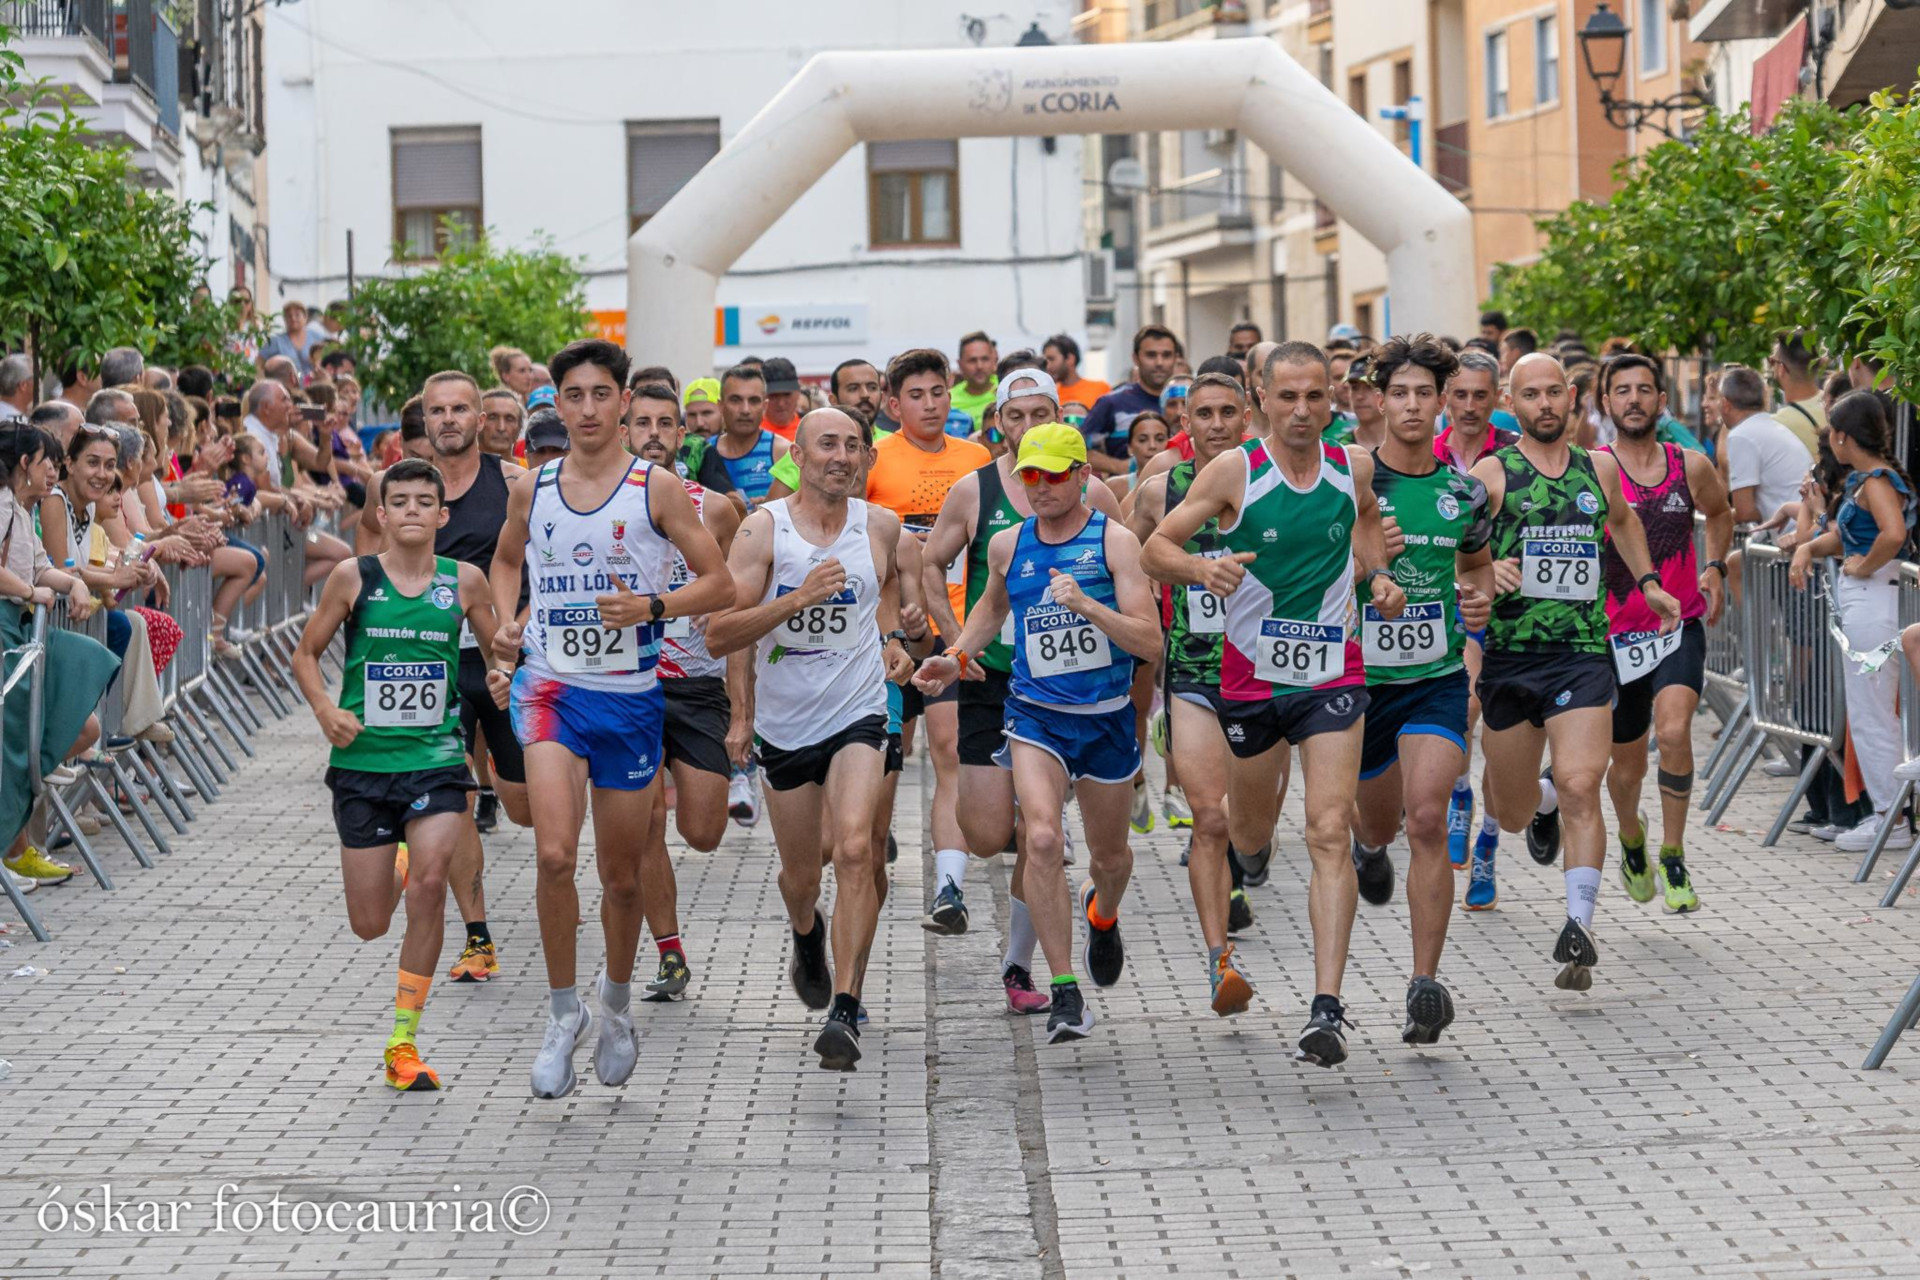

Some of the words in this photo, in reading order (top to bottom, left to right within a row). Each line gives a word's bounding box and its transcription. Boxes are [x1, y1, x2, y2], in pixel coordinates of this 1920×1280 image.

[1041, 92, 1121, 113] CORIA
[791, 317, 851, 330] REPSOL
[1520, 525, 1595, 538] ATLETISMO
[1542, 543, 1586, 554] CORIA
[1536, 559, 1590, 586] 878
[539, 575, 576, 593] DANI
[565, 609, 601, 623] CORI
[1403, 606, 1429, 618] RIA
[787, 607, 847, 634] 885
[1040, 613, 1087, 628] CORIA
[365, 627, 416, 638] TRIATLÓN
[420, 630, 449, 642] CORIA
[1279, 623, 1328, 638] CORIA
[1377, 622, 1435, 652] 869
[562, 628, 624, 657] 892
[1039, 627, 1097, 661] 846
[1271, 640, 1329, 673] 861
[383, 665, 433, 678] CORIA
[378, 682, 437, 711] 826
